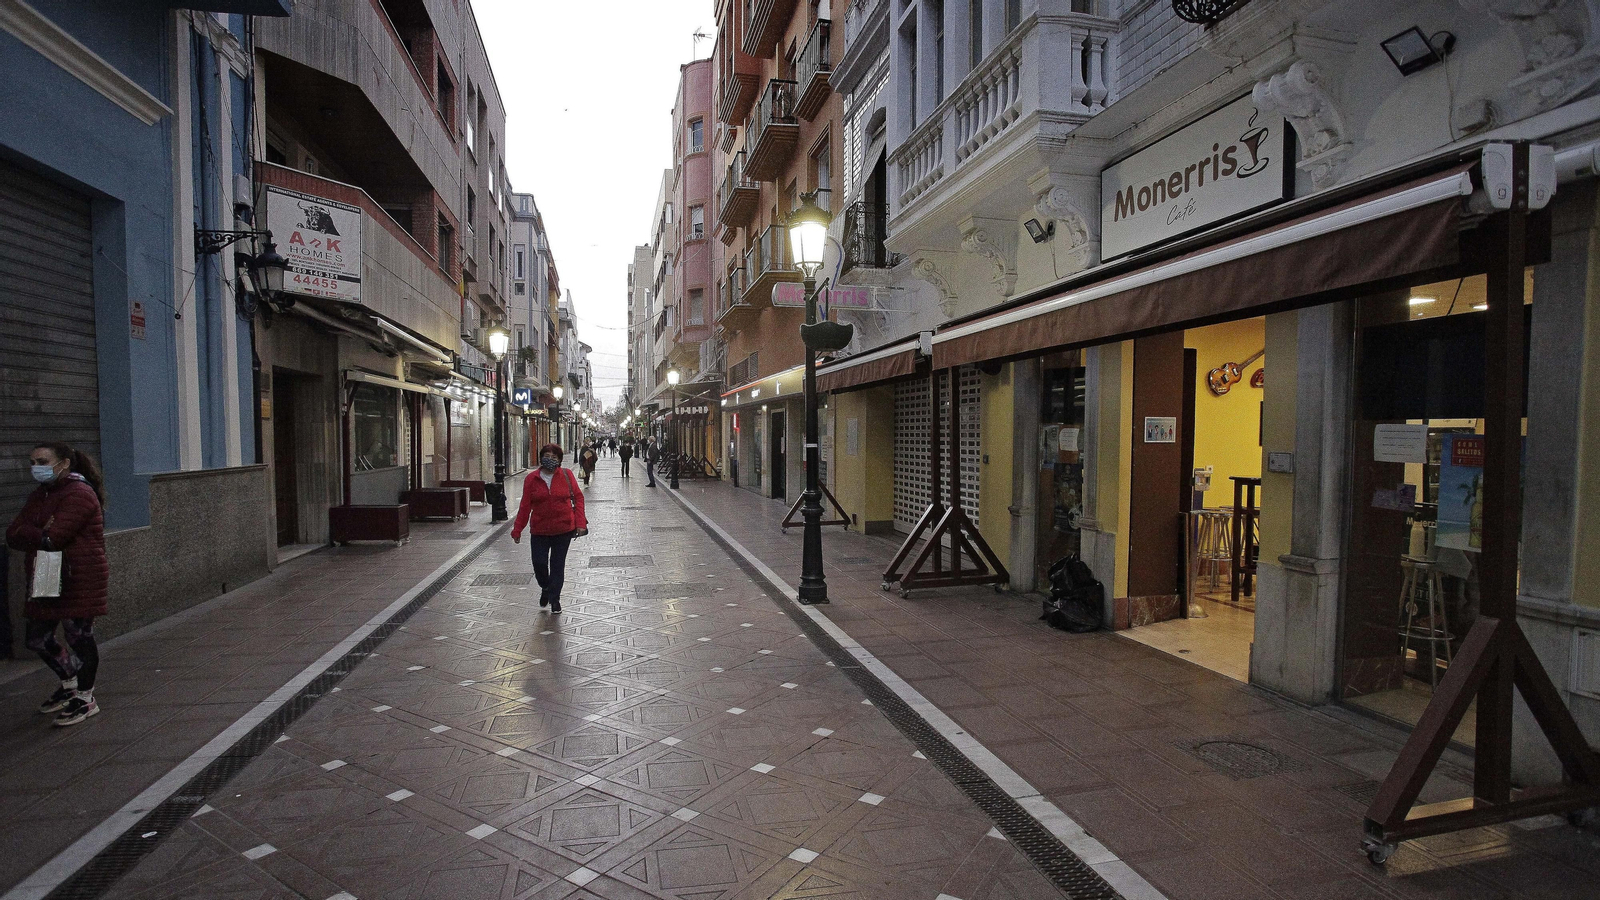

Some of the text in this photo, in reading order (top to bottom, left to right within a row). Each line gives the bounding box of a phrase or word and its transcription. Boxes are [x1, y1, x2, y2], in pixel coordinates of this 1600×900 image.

[268, 186, 301, 198] INTERNATIONAL
[1114, 142, 1238, 223] Monerris
[1166, 197, 1197, 226] Café
[289, 245, 343, 263] HOMES
[293, 274, 338, 290] 44455
[778, 284, 868, 306] Moerris
